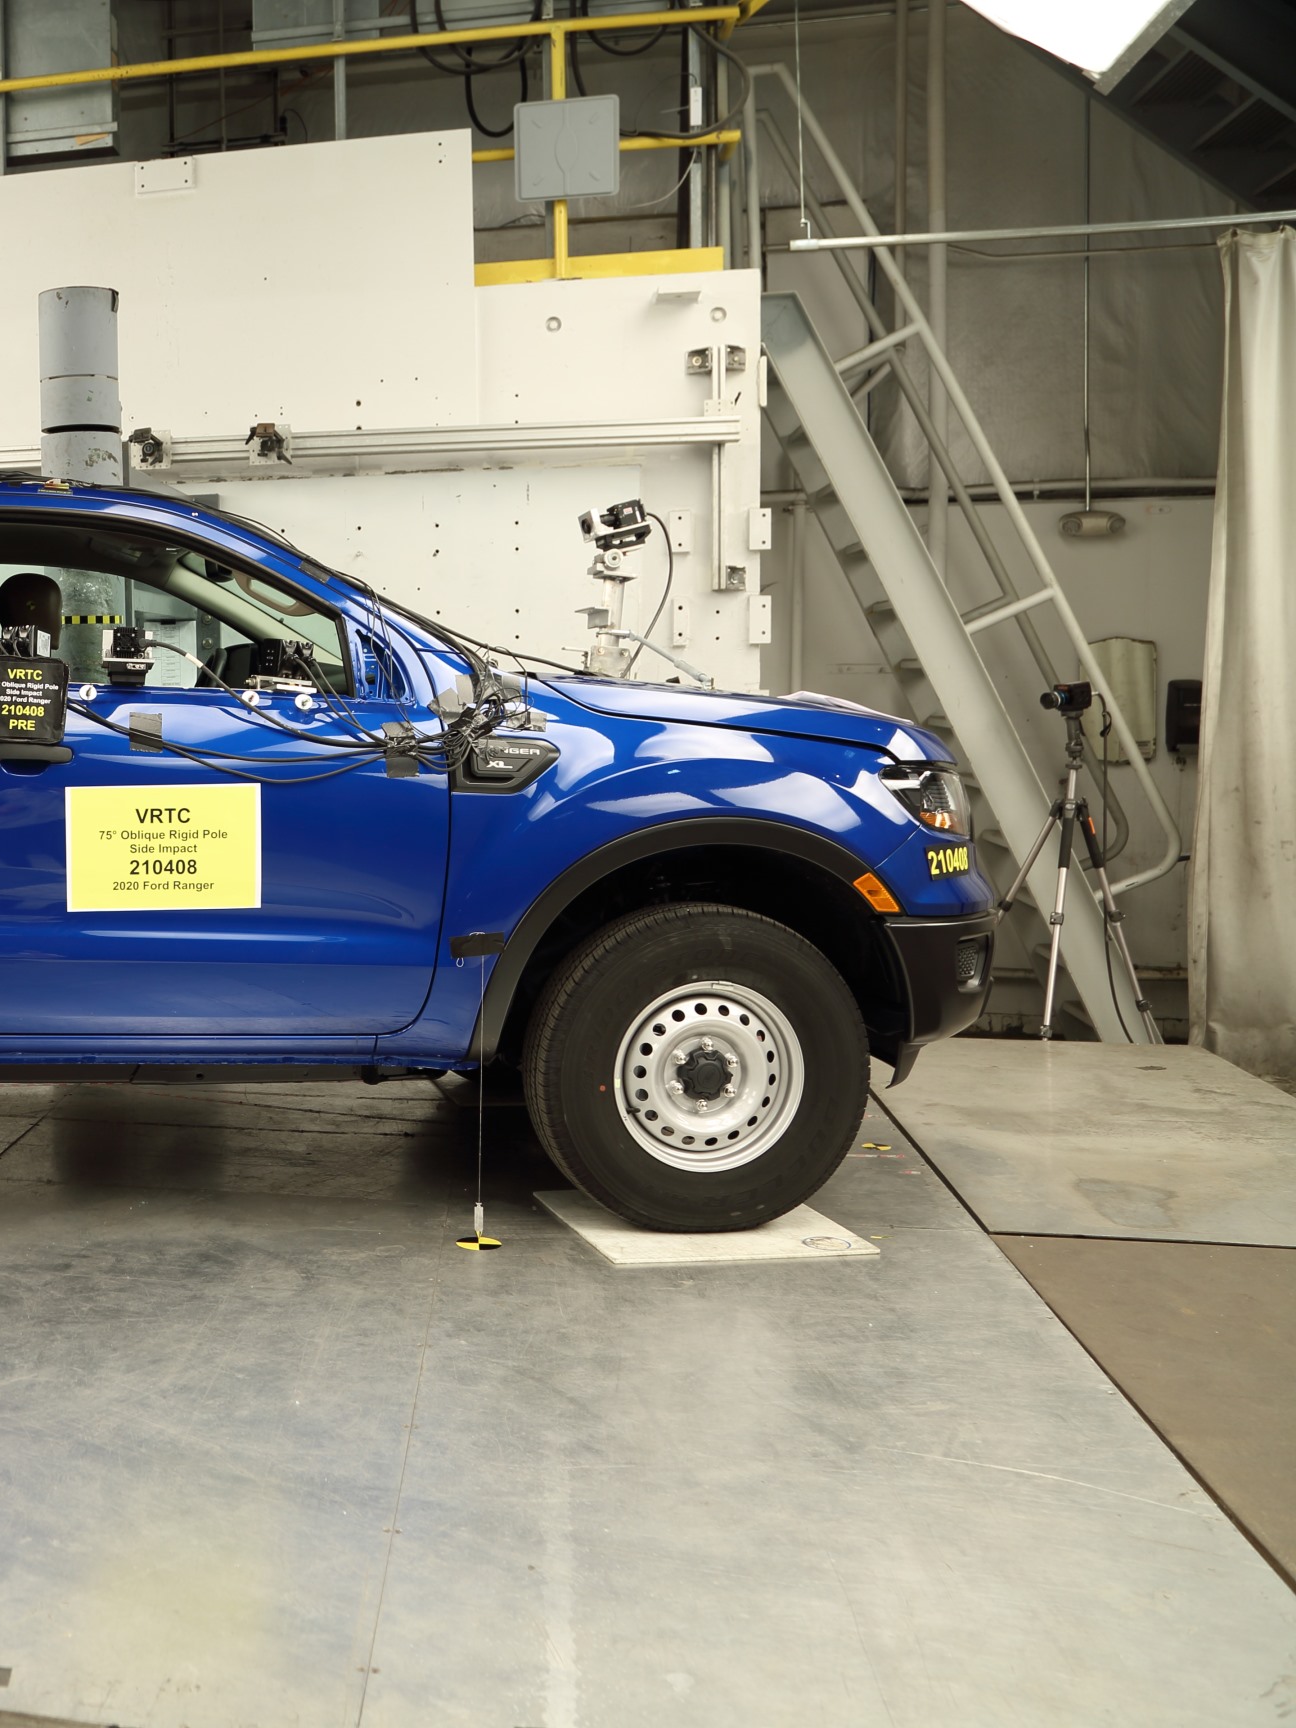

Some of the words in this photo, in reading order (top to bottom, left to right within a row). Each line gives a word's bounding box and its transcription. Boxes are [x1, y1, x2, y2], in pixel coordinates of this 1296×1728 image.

[8, 669, 42, 680] VRTC
[1, 705, 44, 716] 210408
[9, 719, 35, 730] PRE
[496, 747, 541, 756] GER
[486, 760, 514, 769] XL
[136, 808, 191, 824] VRTC
[121, 830, 165, 841] Oblique
[169, 829, 199, 841] Rigid
[203, 830, 228, 839] Pole
[129, 844, 155, 854] Side
[158, 844, 198, 855] Impact
[927, 846, 969, 875] 210408
[129, 859, 197, 875] 210408
[112, 881, 139, 891] 2020
[143, 881, 169, 891] Ford
[173, 881, 214, 892] Ranger
